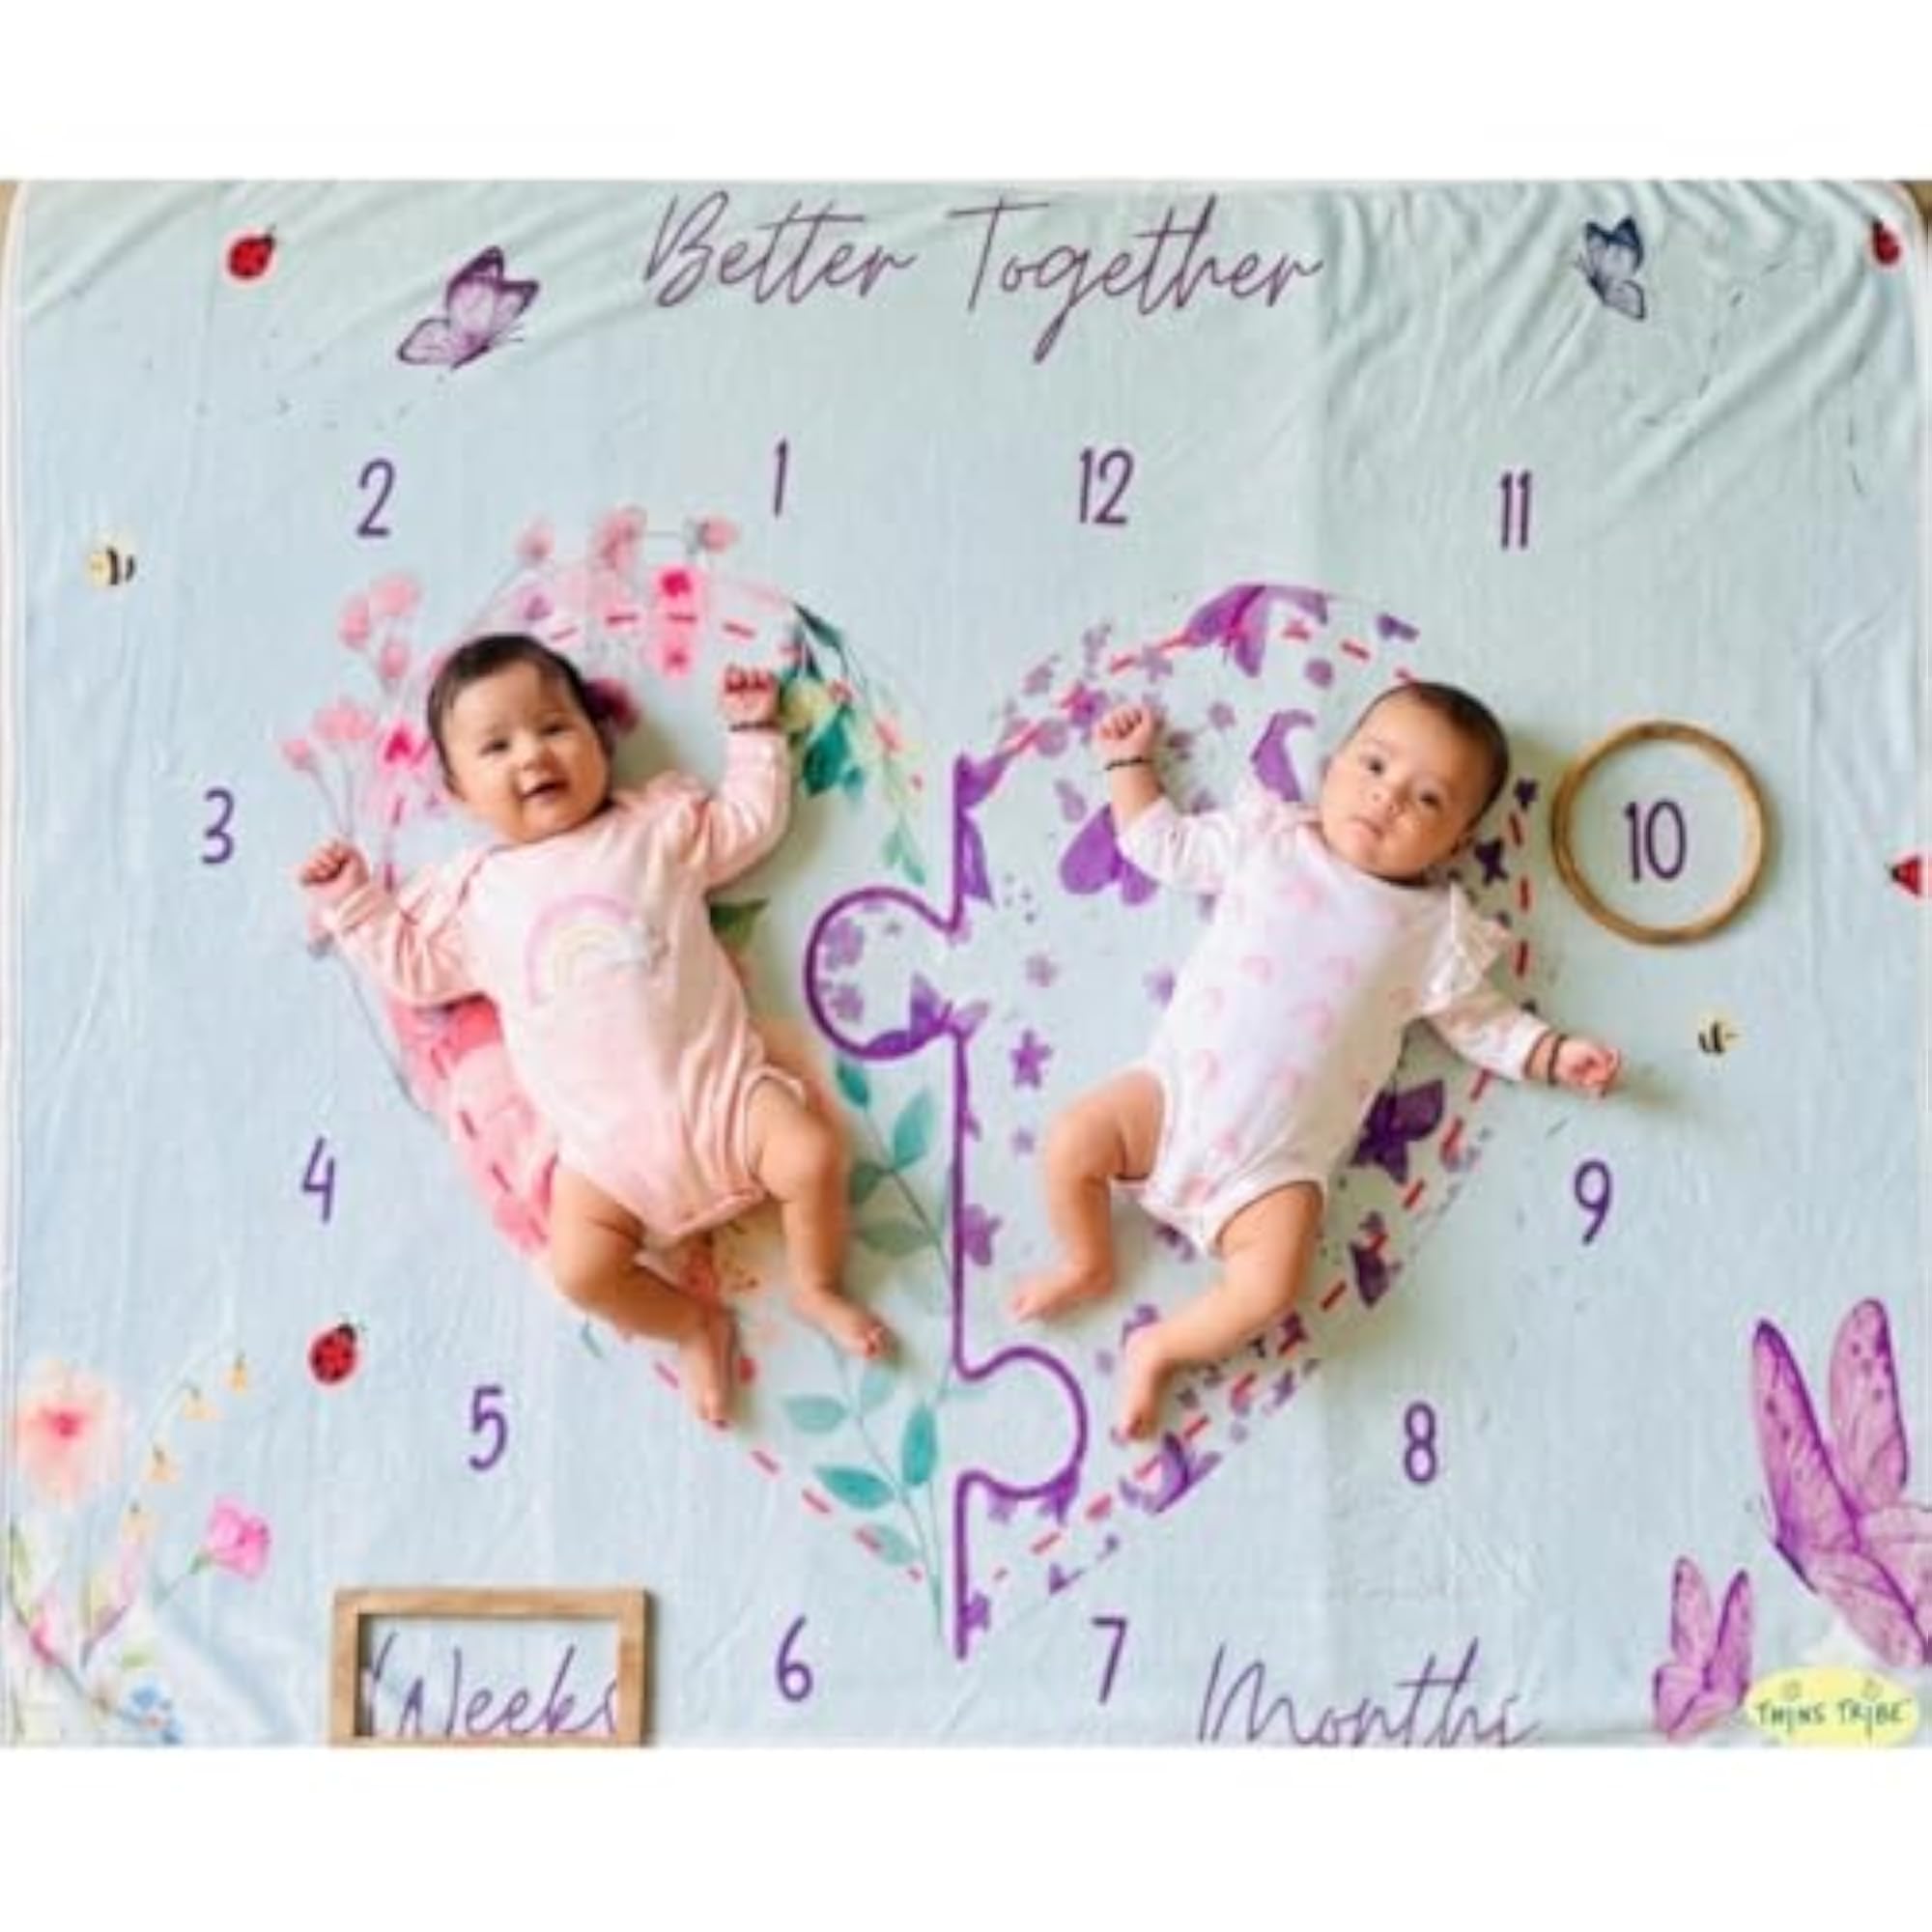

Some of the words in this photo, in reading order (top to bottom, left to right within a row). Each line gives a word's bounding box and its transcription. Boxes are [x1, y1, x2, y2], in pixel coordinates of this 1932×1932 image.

[642, 189, 918, 308] Better
[948, 193, 1325, 364] Together
[356, 458, 397, 539] 2
[772, 439, 790, 517] 1
[1079, 447, 1134, 526] 12
[1499, 470, 1533, 550] 11
[201, 787, 235, 866] 3
[1623, 800, 1688, 883] 10
[300, 1136, 336, 1223] 4
[1574, 1159, 1612, 1245] 9
[469, 1384, 509, 1472] 5
[1403, 1401, 1439, 1486] 8
[776, 1616, 814, 1703] 6
[1091, 1617, 1128, 1704] 7
[1198, 1636, 1542, 1746] Months
[1837, 1697, 1912, 1740] TRIBE
